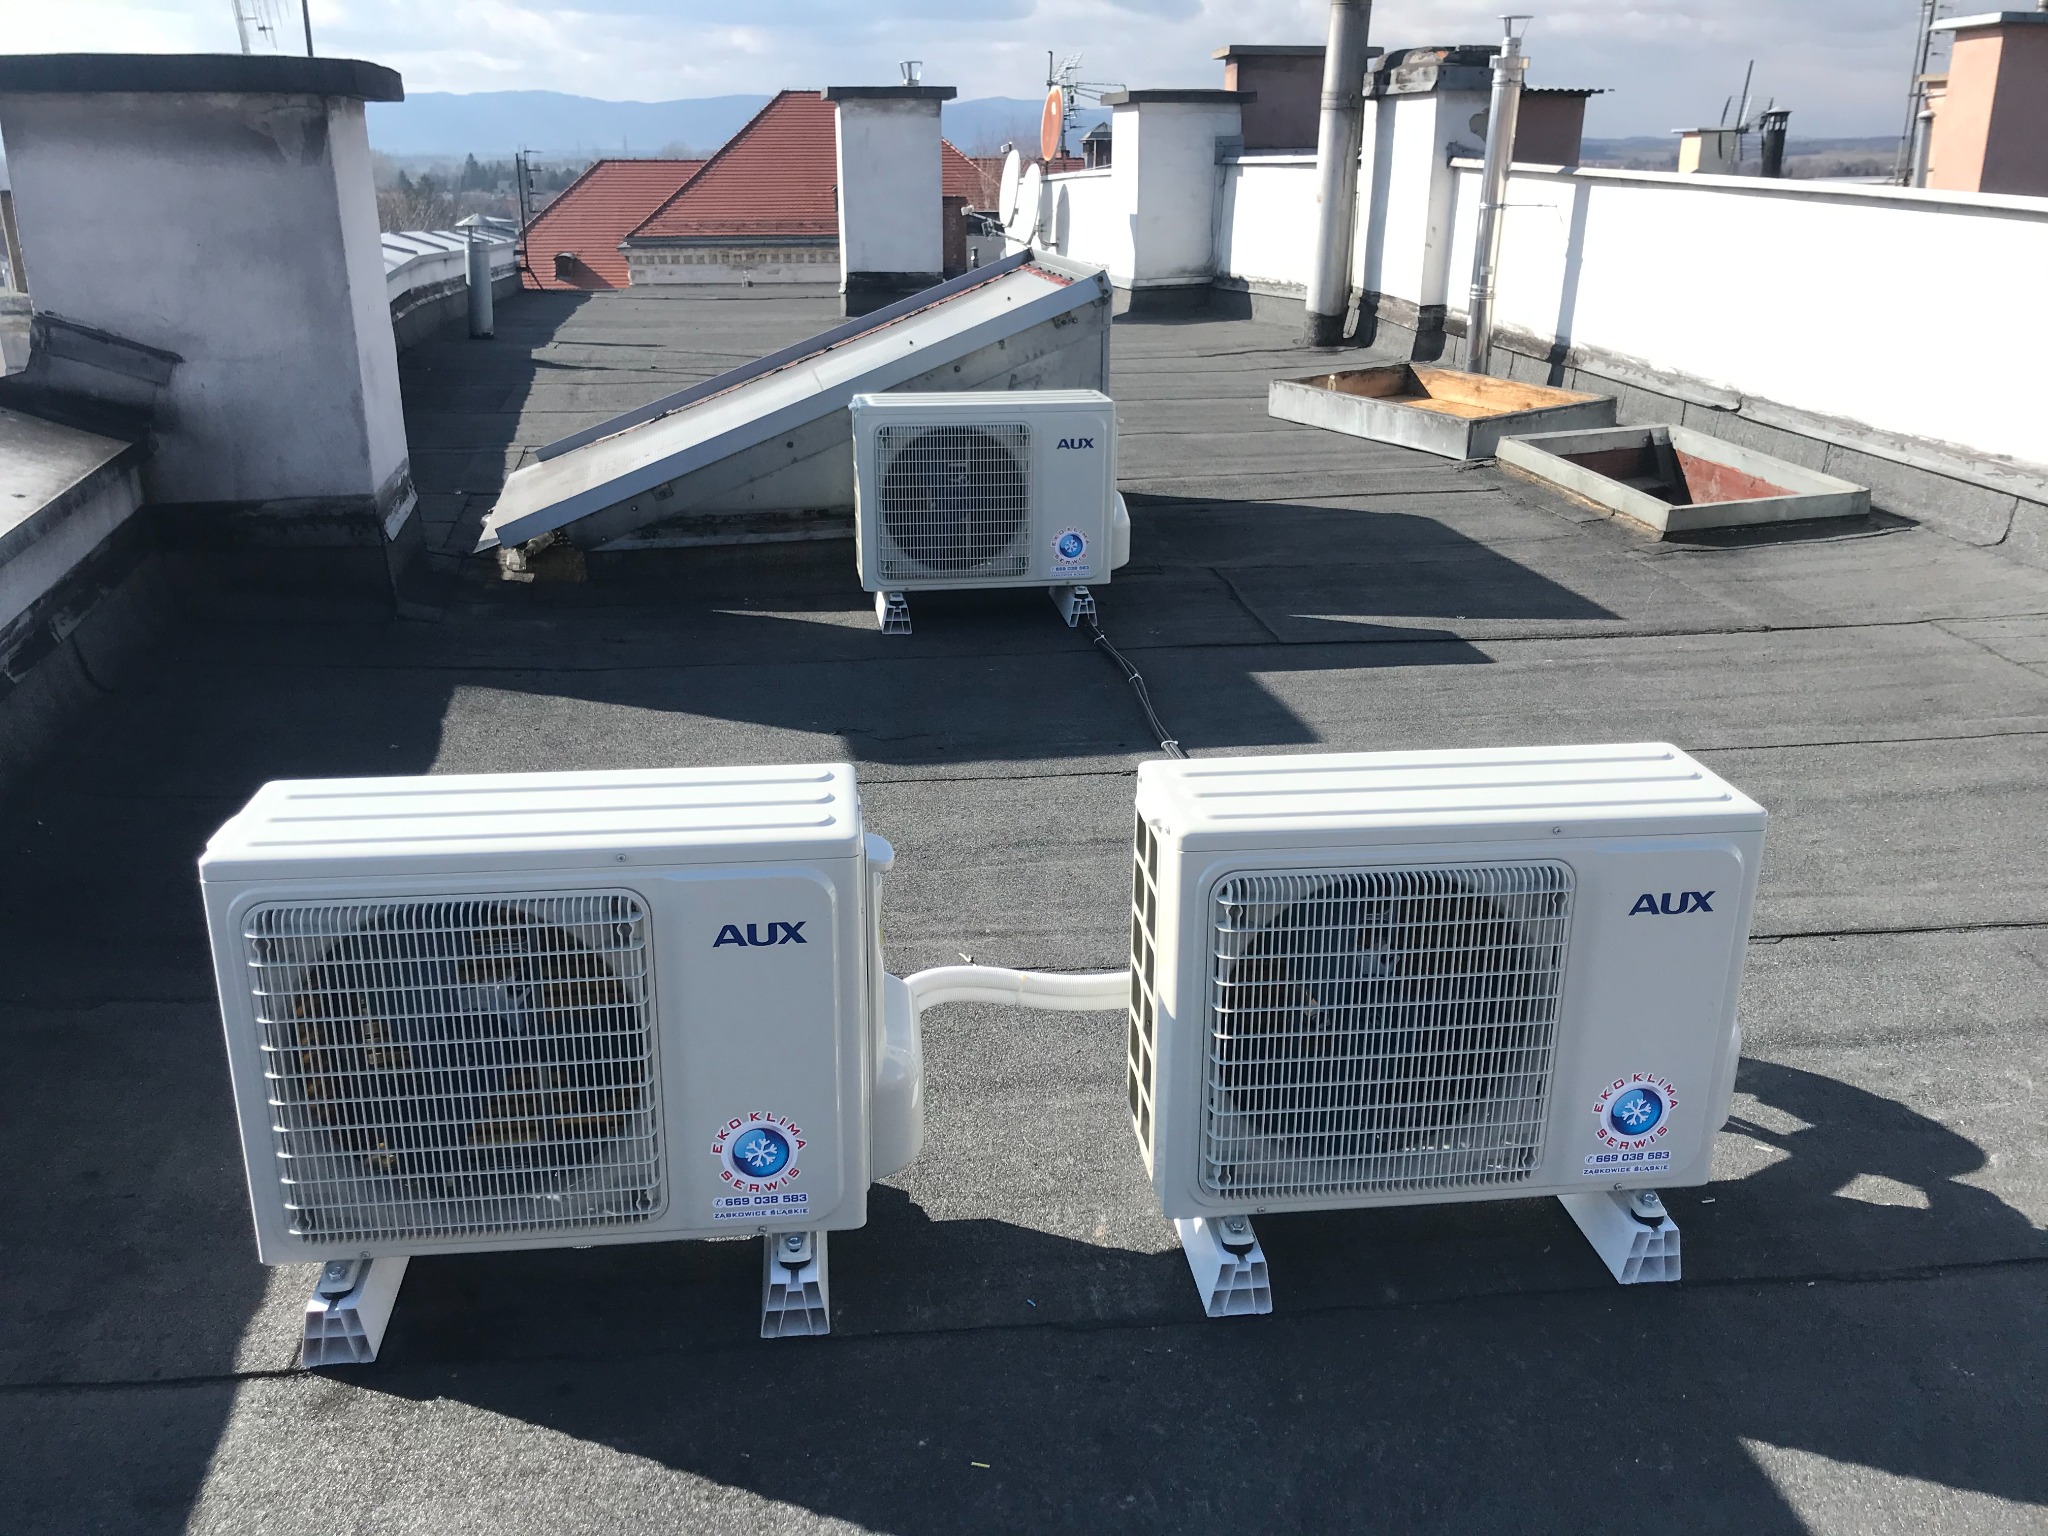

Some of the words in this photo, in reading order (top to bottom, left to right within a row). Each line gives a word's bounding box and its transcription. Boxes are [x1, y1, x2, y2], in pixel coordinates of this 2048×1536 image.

[1057, 438, 1094, 450] AUX
[1628, 890, 1716, 916] AUX
[712, 921, 808, 948] AUX
[1594, 1079, 1625, 1112] EKO
[1633, 1073, 1678, 1109] KLIMA
[712, 1118, 742, 1154] EKO
[750, 1112, 806, 1150] KLIMA
[1596, 1126, 1668, 1150] SERWIS
[1596, 1154, 1618, 1162] 669
[1622, 1153, 1644, 1161] 038
[720, 1168, 800, 1192] SERWIS
[725, 1197, 750, 1206] 669
[754, 1196, 778, 1204] 038
